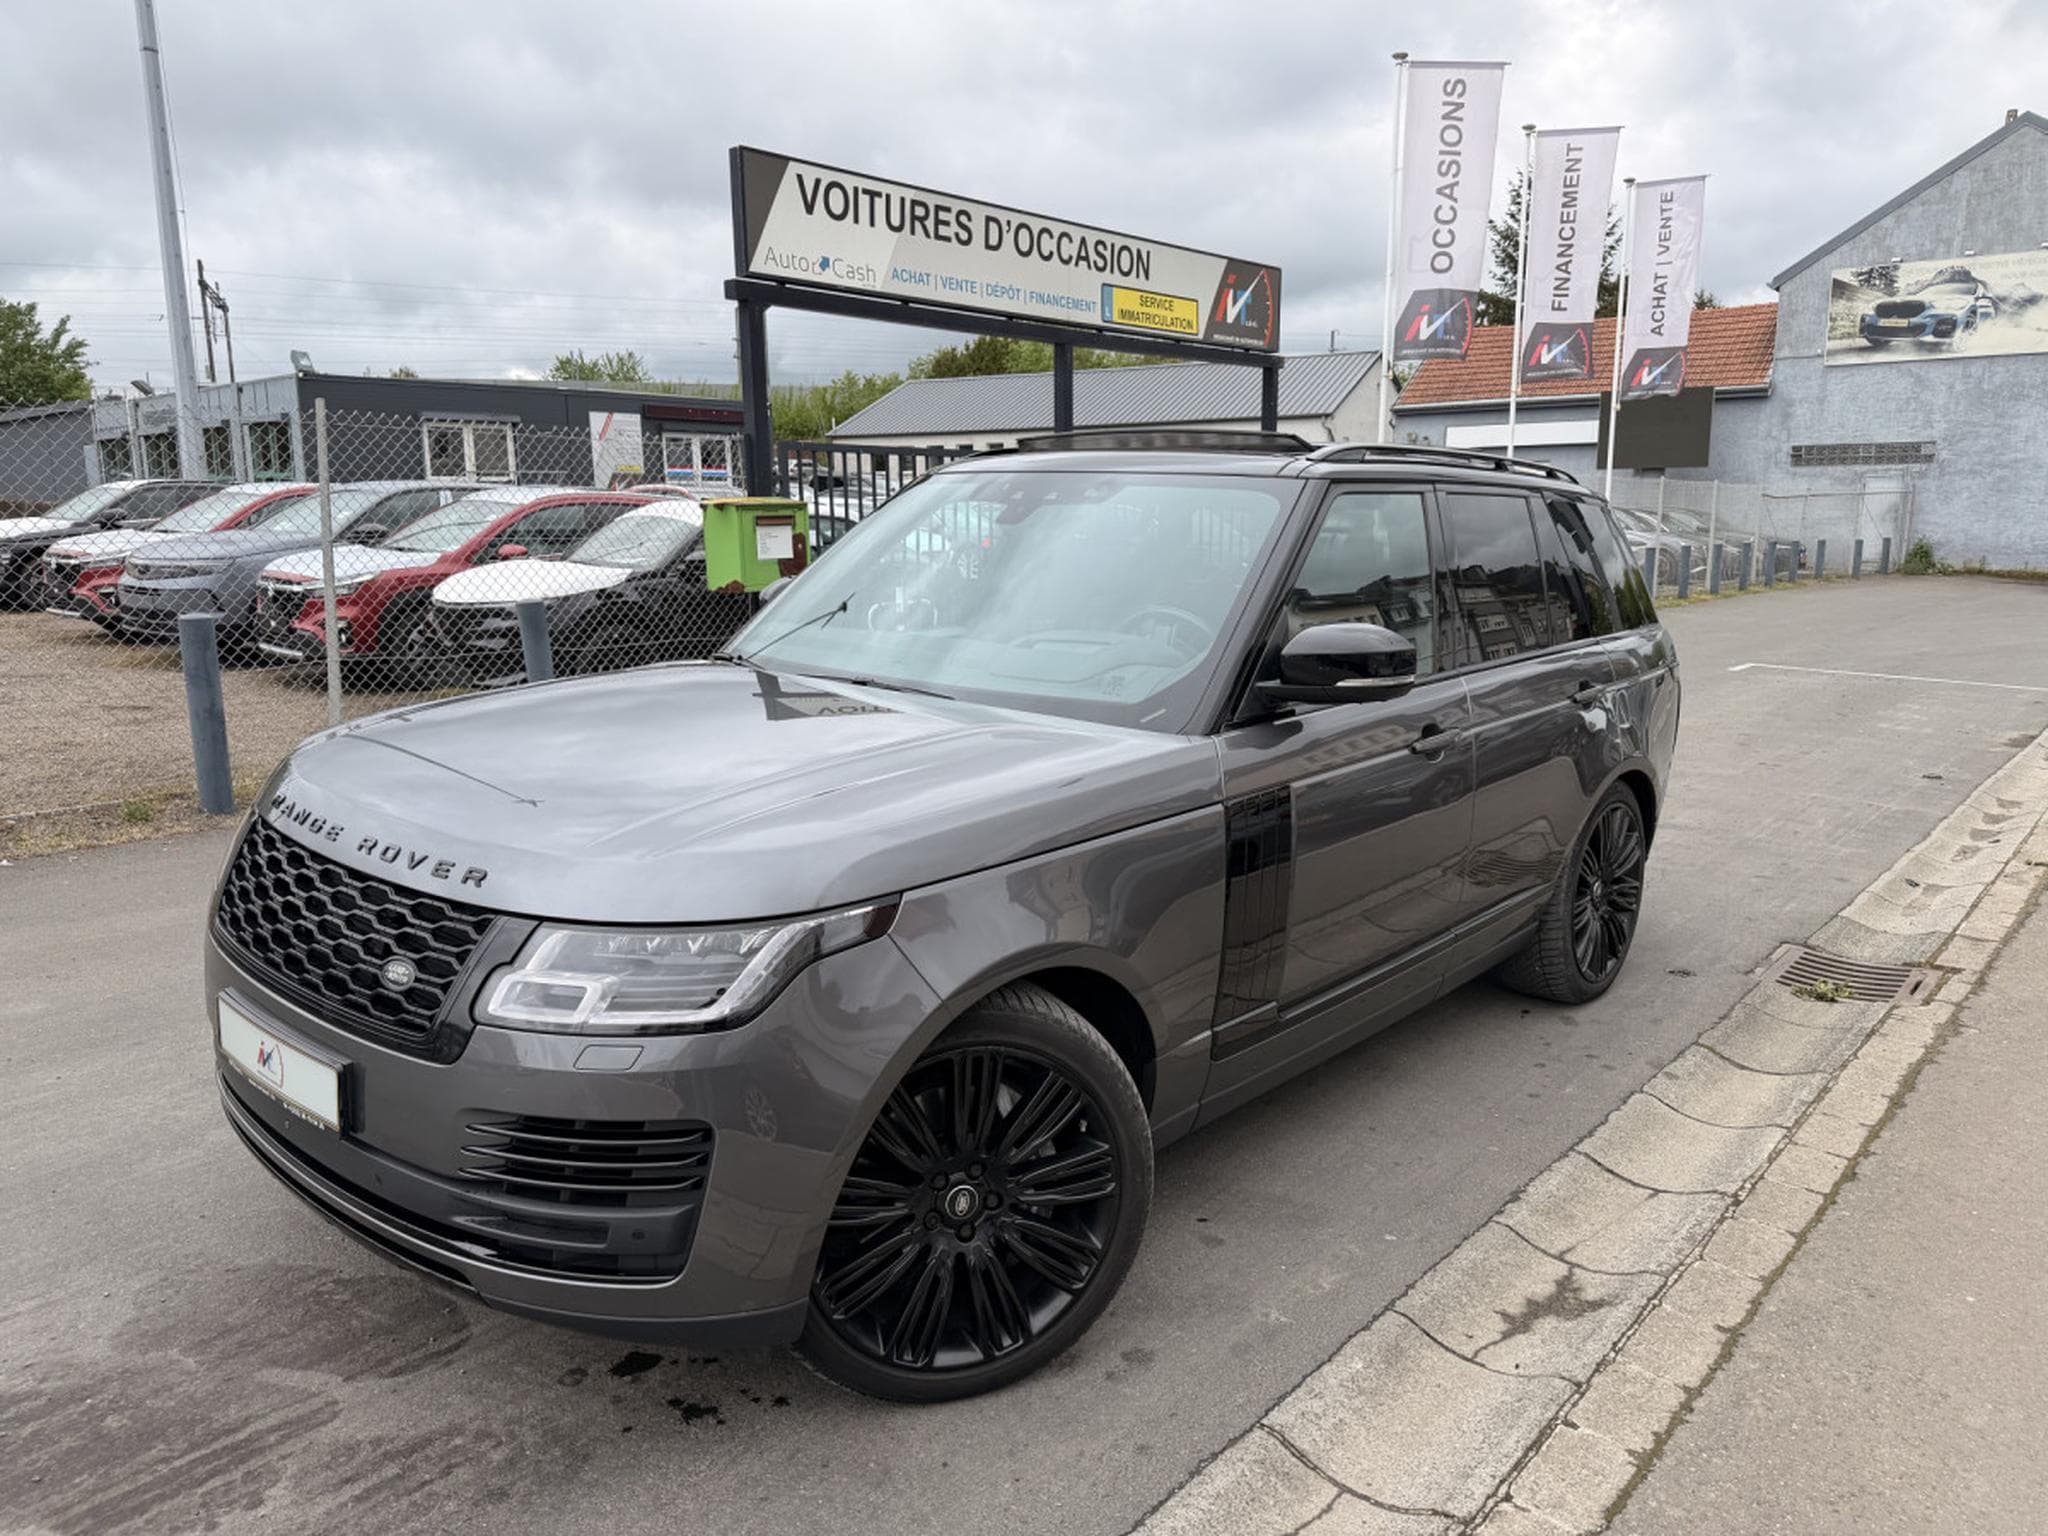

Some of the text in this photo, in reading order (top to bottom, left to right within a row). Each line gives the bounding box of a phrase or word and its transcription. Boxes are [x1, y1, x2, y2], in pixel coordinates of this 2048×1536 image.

[1430, 77, 1467, 274] OCCASIONS
[764, 246, 877, 283] Auto Cash
[795, 173, 1151, 281] VOITURES D'OCCASION
[1551, 142, 1584, 312] FINANCEMENT
[1650, 190, 1675, 337] ACHAT VENTE
[891, 267, 1097, 313] ACHAT VENTE DÉPÔT FINANCEMENT
[1117, 308, 1194, 331] IMMATRICULATION
[1138, 294, 1175, 312] SERVICE
[270, 794, 489, 888] RANGE ROVER
